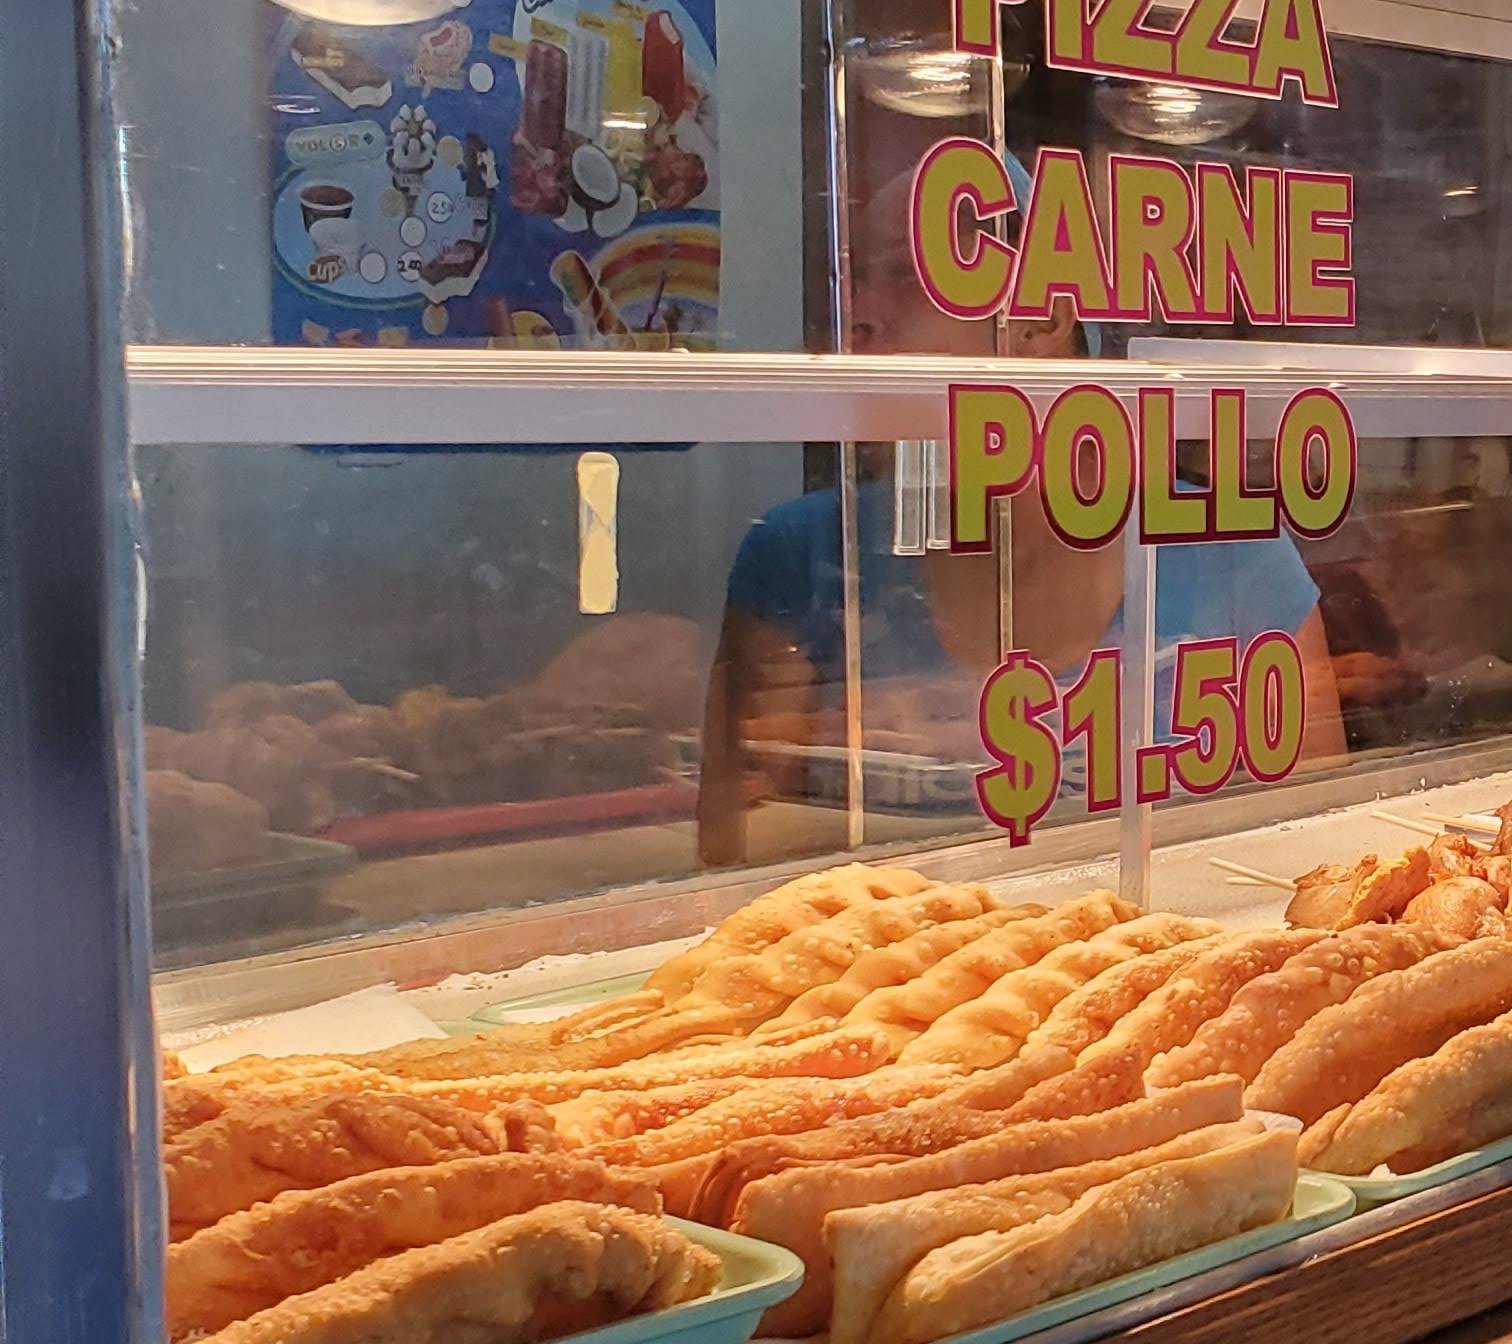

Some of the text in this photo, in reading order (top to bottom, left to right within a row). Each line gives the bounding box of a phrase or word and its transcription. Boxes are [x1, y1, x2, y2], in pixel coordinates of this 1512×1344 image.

[910, 136, 1356, 327] CARNE
[947, 383, 1356, 555] POLLO
[975, 630, 1306, 847] $1.50
